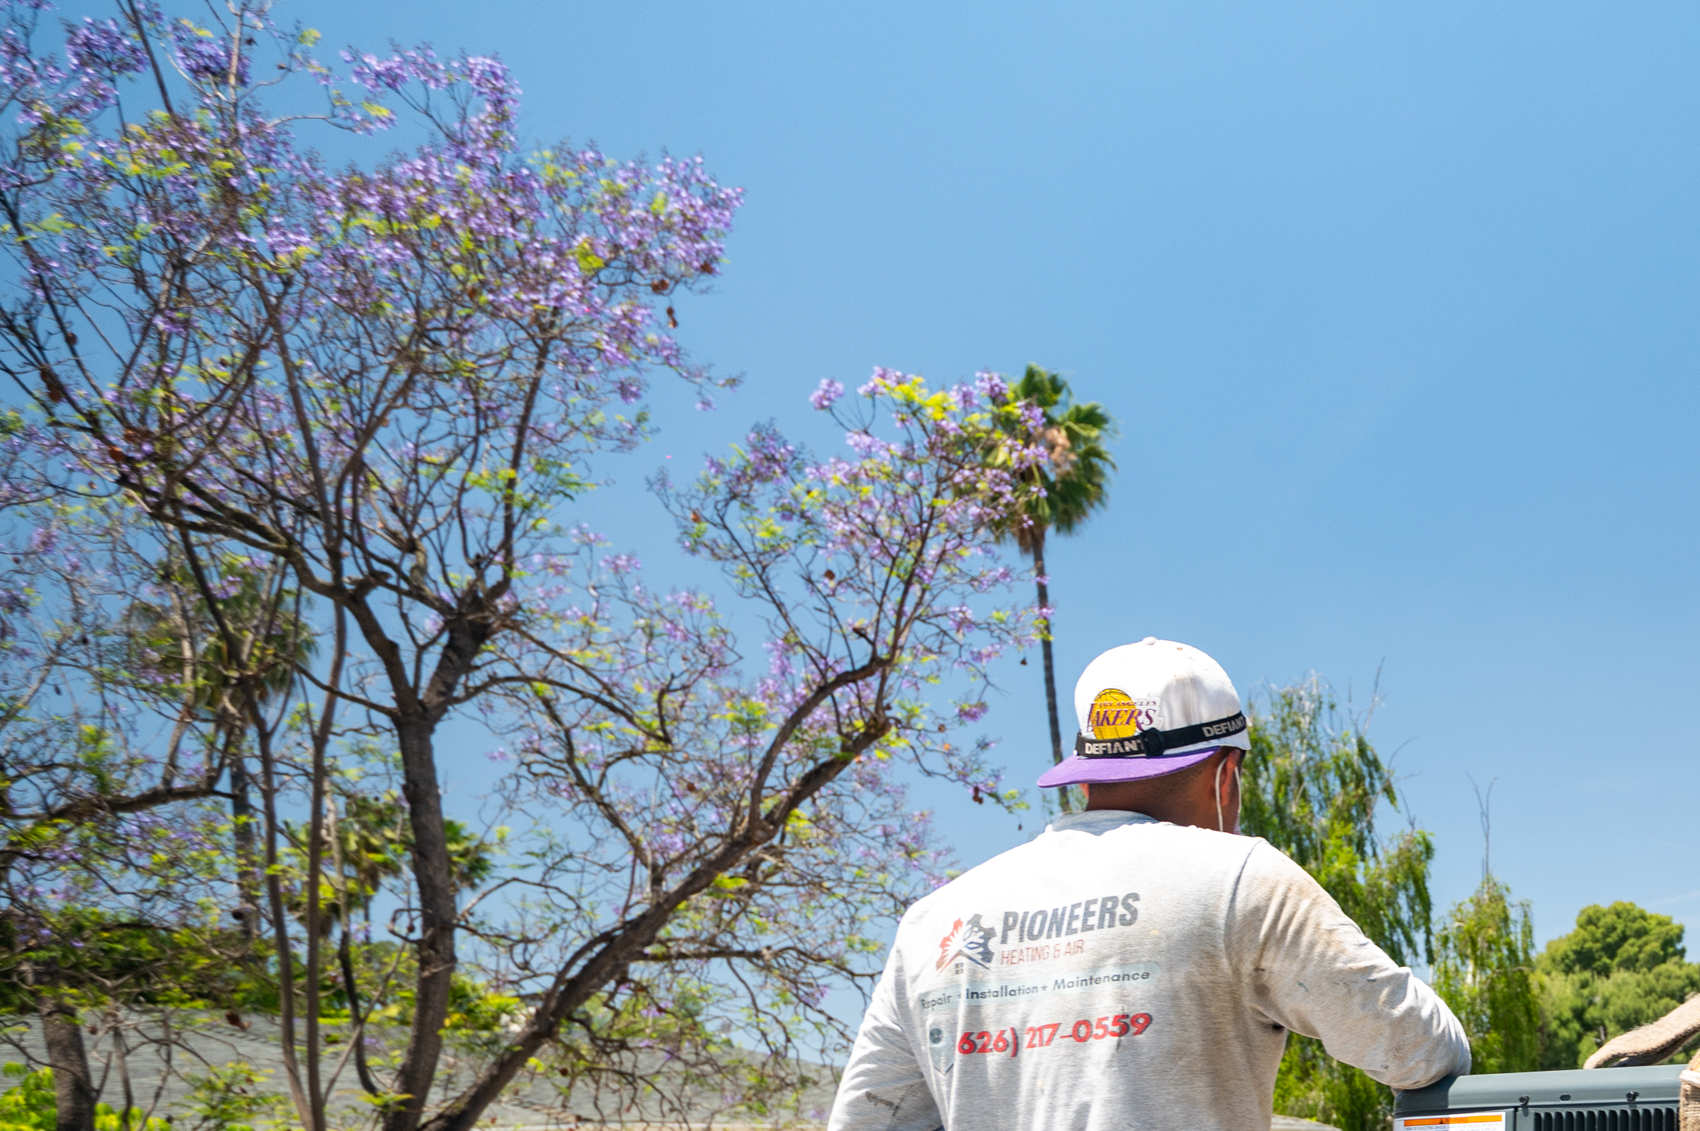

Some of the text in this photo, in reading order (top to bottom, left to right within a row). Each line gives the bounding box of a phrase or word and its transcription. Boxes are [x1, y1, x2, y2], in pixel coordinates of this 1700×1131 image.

[1087, 703, 1157, 732] LAKERS
[1000, 892, 1141, 945] PIONEERS
[1000, 939, 1085, 965] HEATING & AIR
[921, 972, 1150, 1010] Repair Installation Maintenance
[1025, 1013, 1153, 1049] 217-0559
